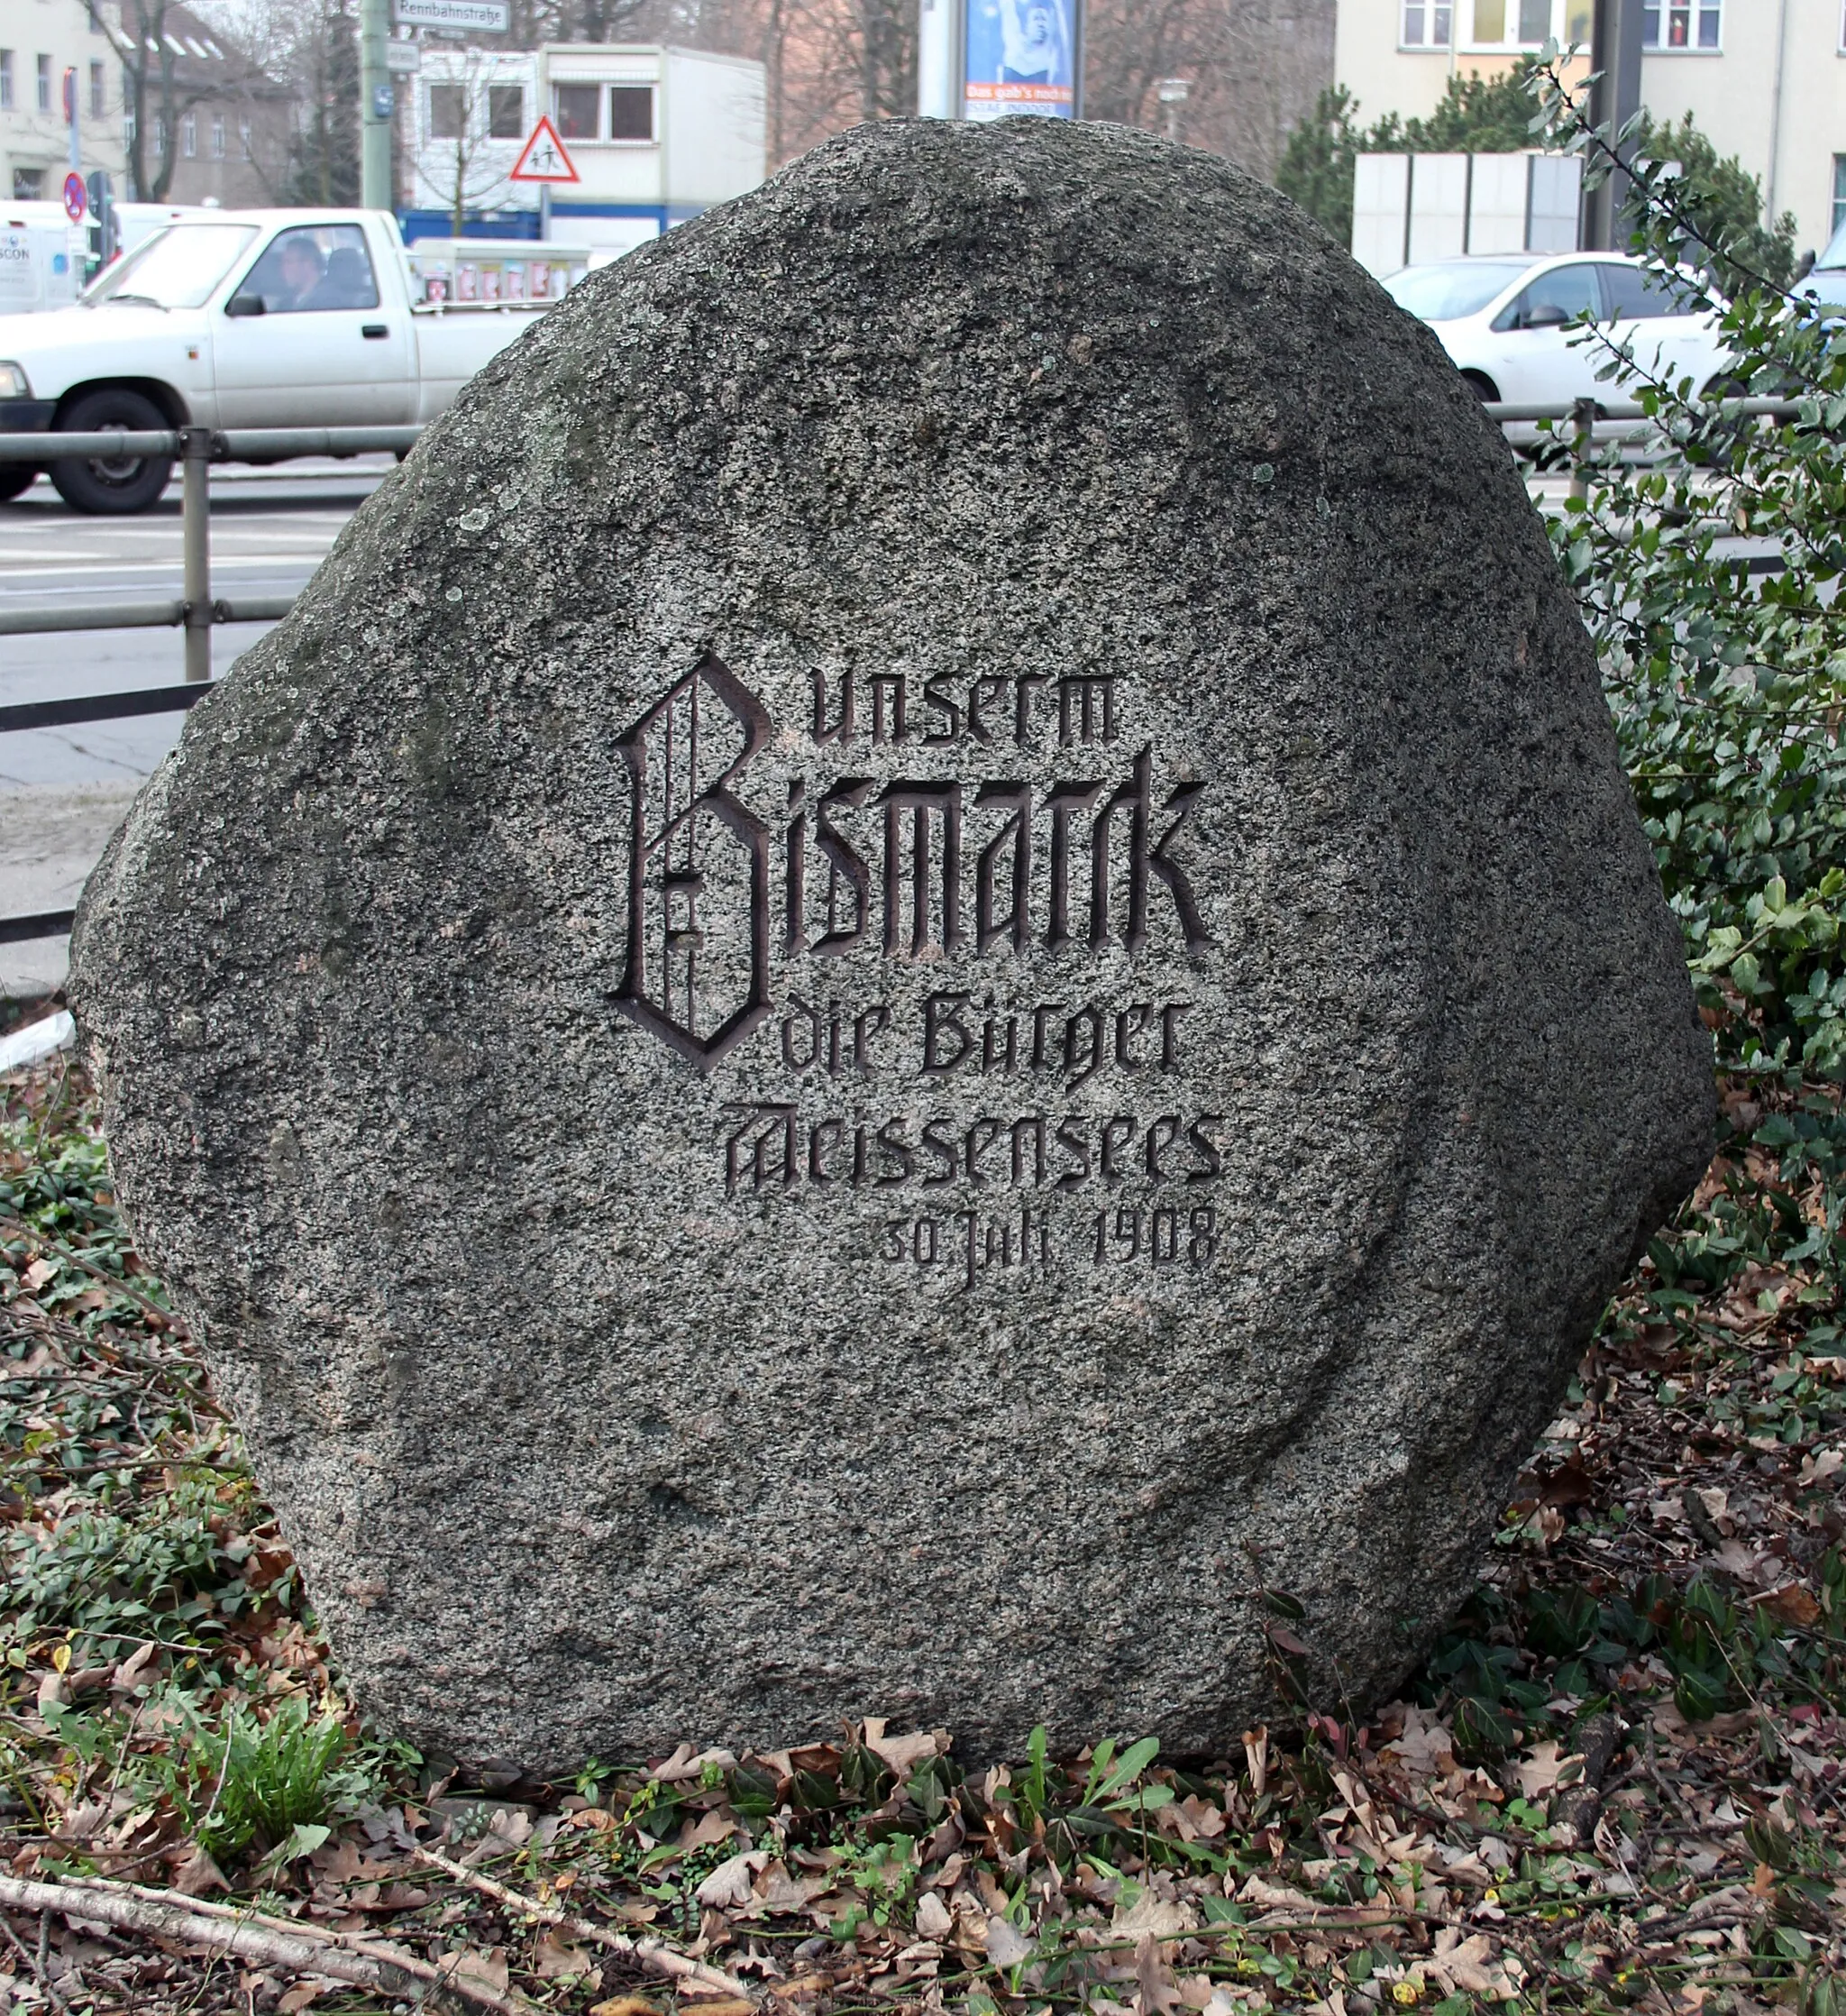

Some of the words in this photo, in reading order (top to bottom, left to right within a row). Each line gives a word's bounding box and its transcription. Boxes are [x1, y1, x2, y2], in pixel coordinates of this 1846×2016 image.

[400, 0, 501, 24] Rennbahnstraße
[966, 86, 992, 98] Das
[809, 666, 1117, 747] unserm
[609, 648, 1217, 1075] Bismarck
[781, 993, 891, 1077] die
[918, 993, 1193, 1097] Bürger
[721, 1102, 1224, 1191] Weissensees
[1092, 1206, 1217, 1266] 1908
